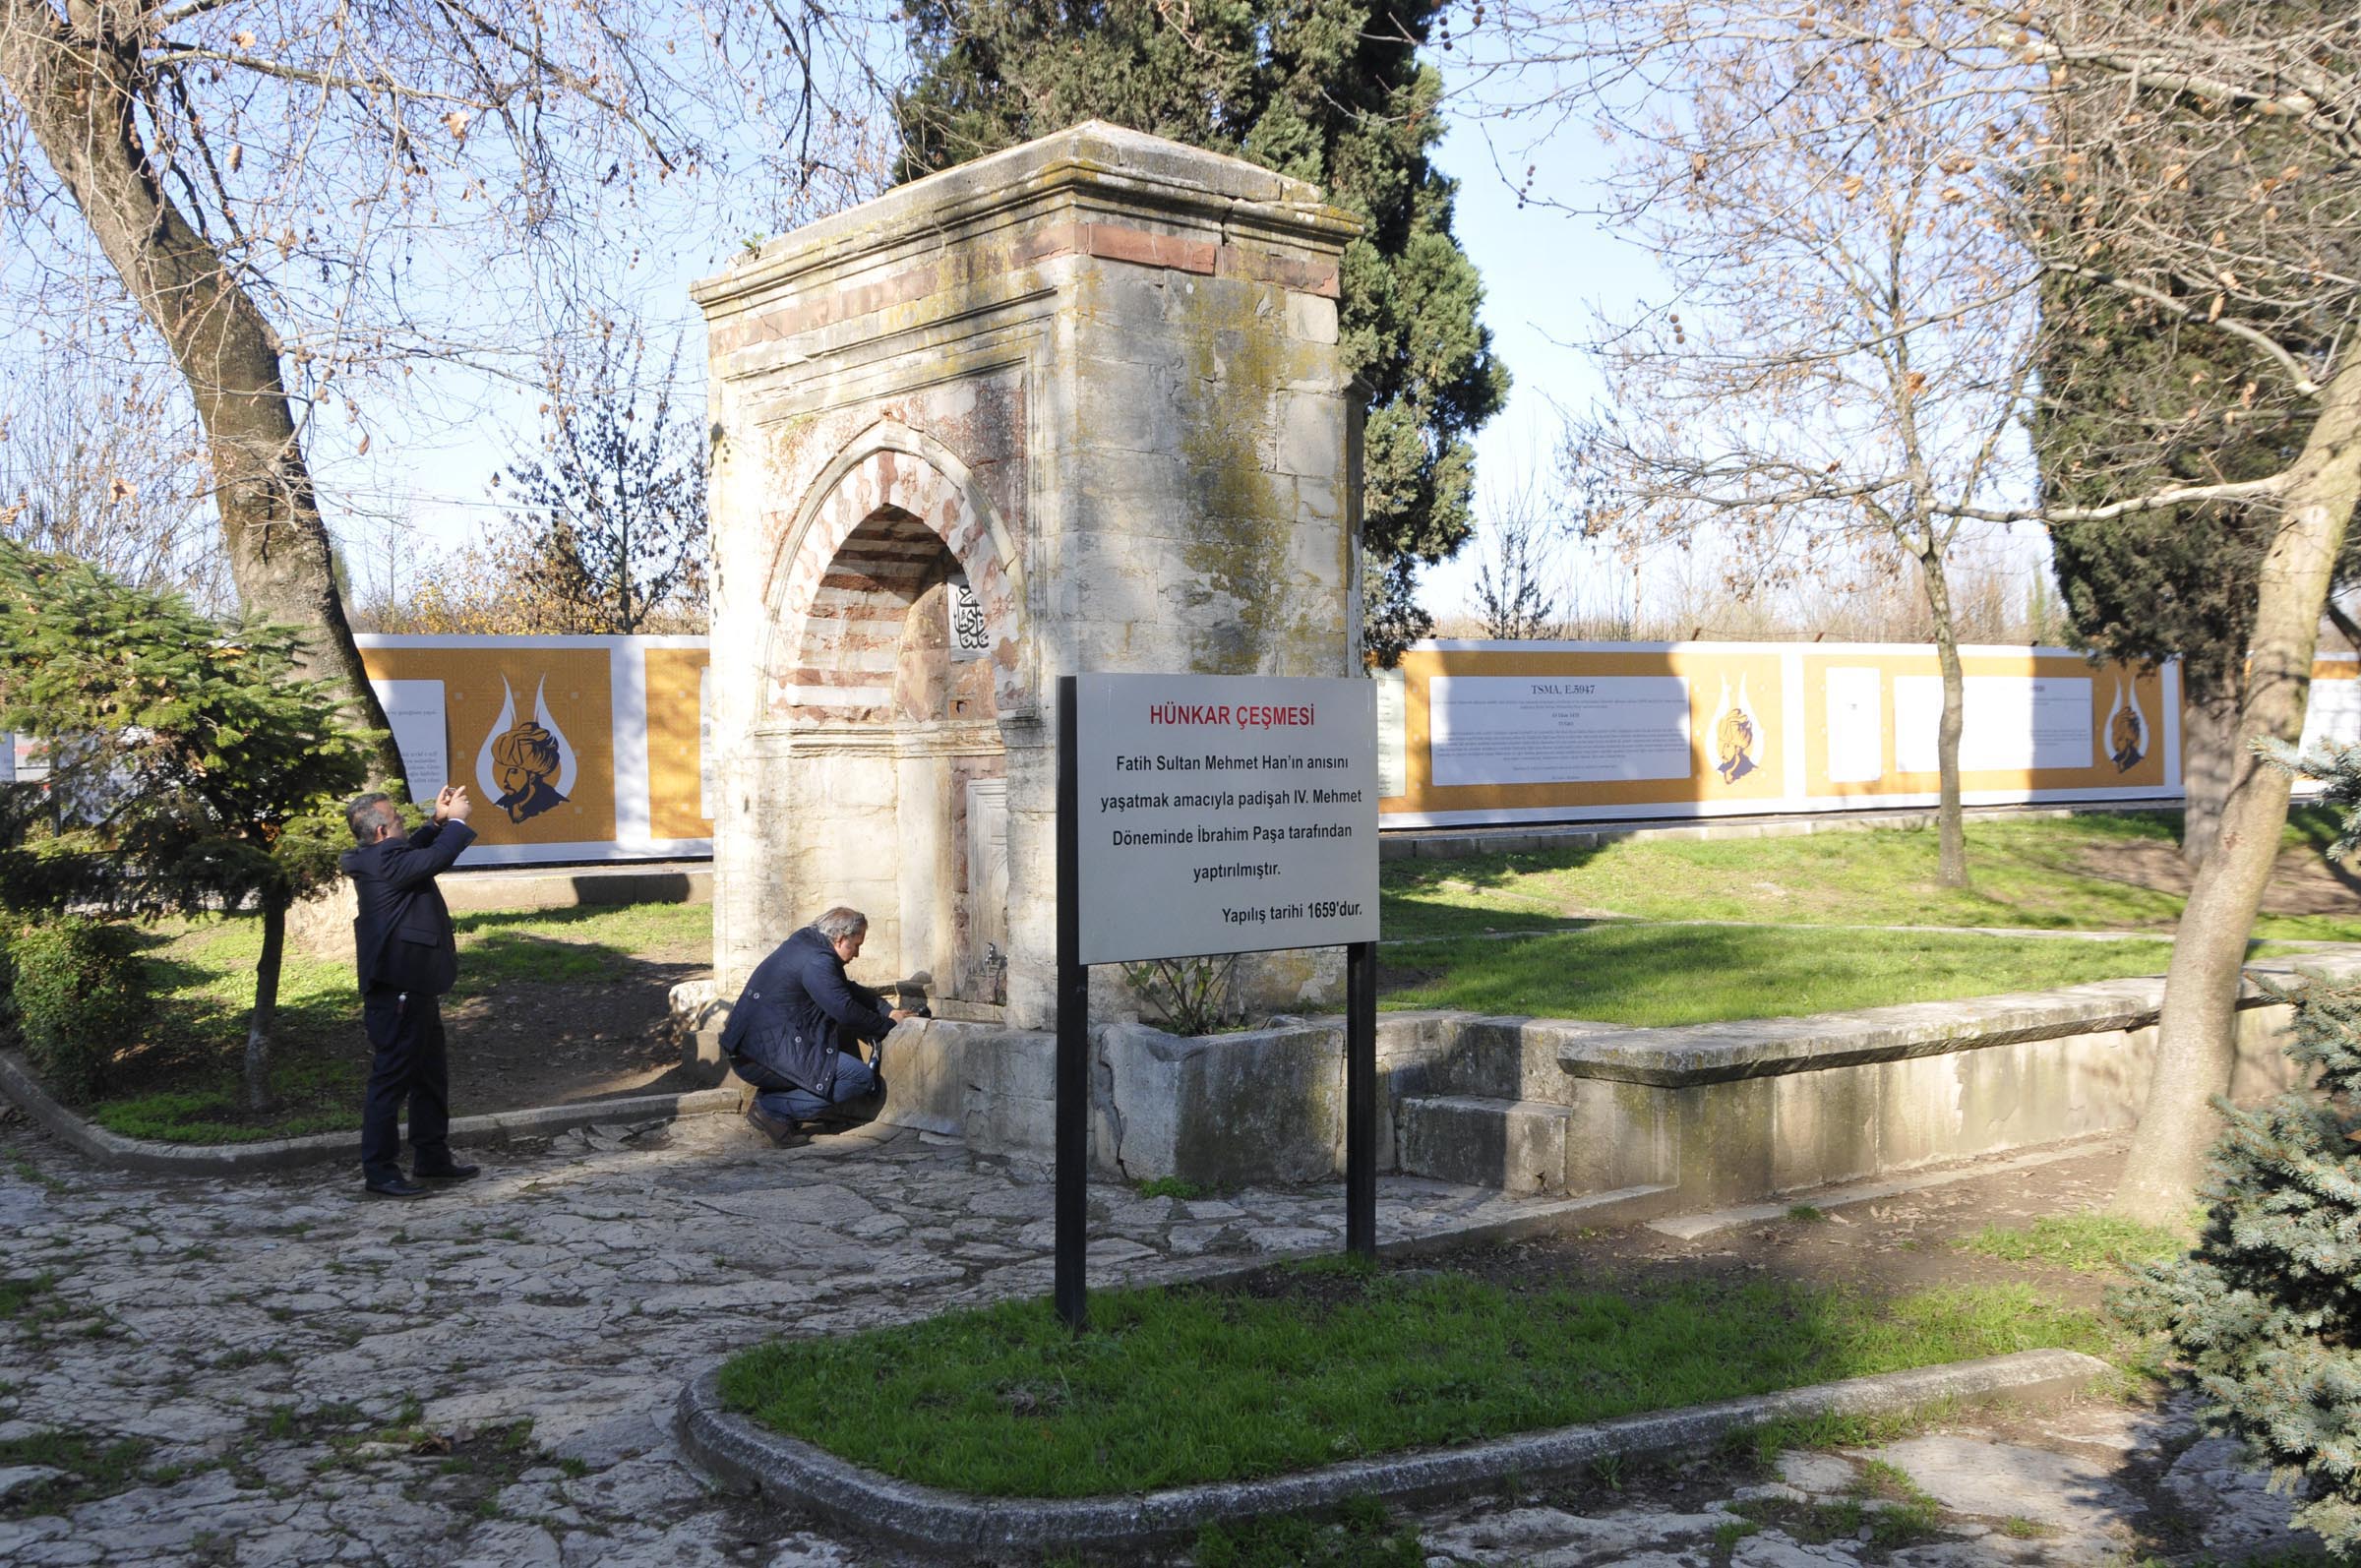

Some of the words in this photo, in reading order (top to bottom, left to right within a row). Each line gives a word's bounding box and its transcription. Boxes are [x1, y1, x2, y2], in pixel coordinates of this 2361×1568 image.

[1151, 701, 1230, 724] HÜNKAR
[1237, 703, 1313, 730] ÇEŞMESİ
[1117, 755, 1151, 770] Fatih
[1157, 755, 1200, 770] Sultan
[1206, 755, 1258, 769] Mehmet
[1307, 758, 1348, 768] anısını
[1101, 793, 1169, 813] yaşatmak
[1174, 791, 1234, 810] amacıyla
[1239, 790, 1290, 809] padişah
[1295, 790, 1308, 804] IV.
[1313, 789, 1362, 803] Mehmet
[1114, 828, 1193, 846] Döneminde
[1198, 824, 1248, 842] İbrahim
[1253, 826, 1284, 843] Paşa
[1289, 823, 1352, 839] tarafından
[1193, 862, 1280, 883] yaptırılmıştır.
[1222, 907, 1266, 926] Yapılış
[1270, 904, 1302, 920] tarihi
